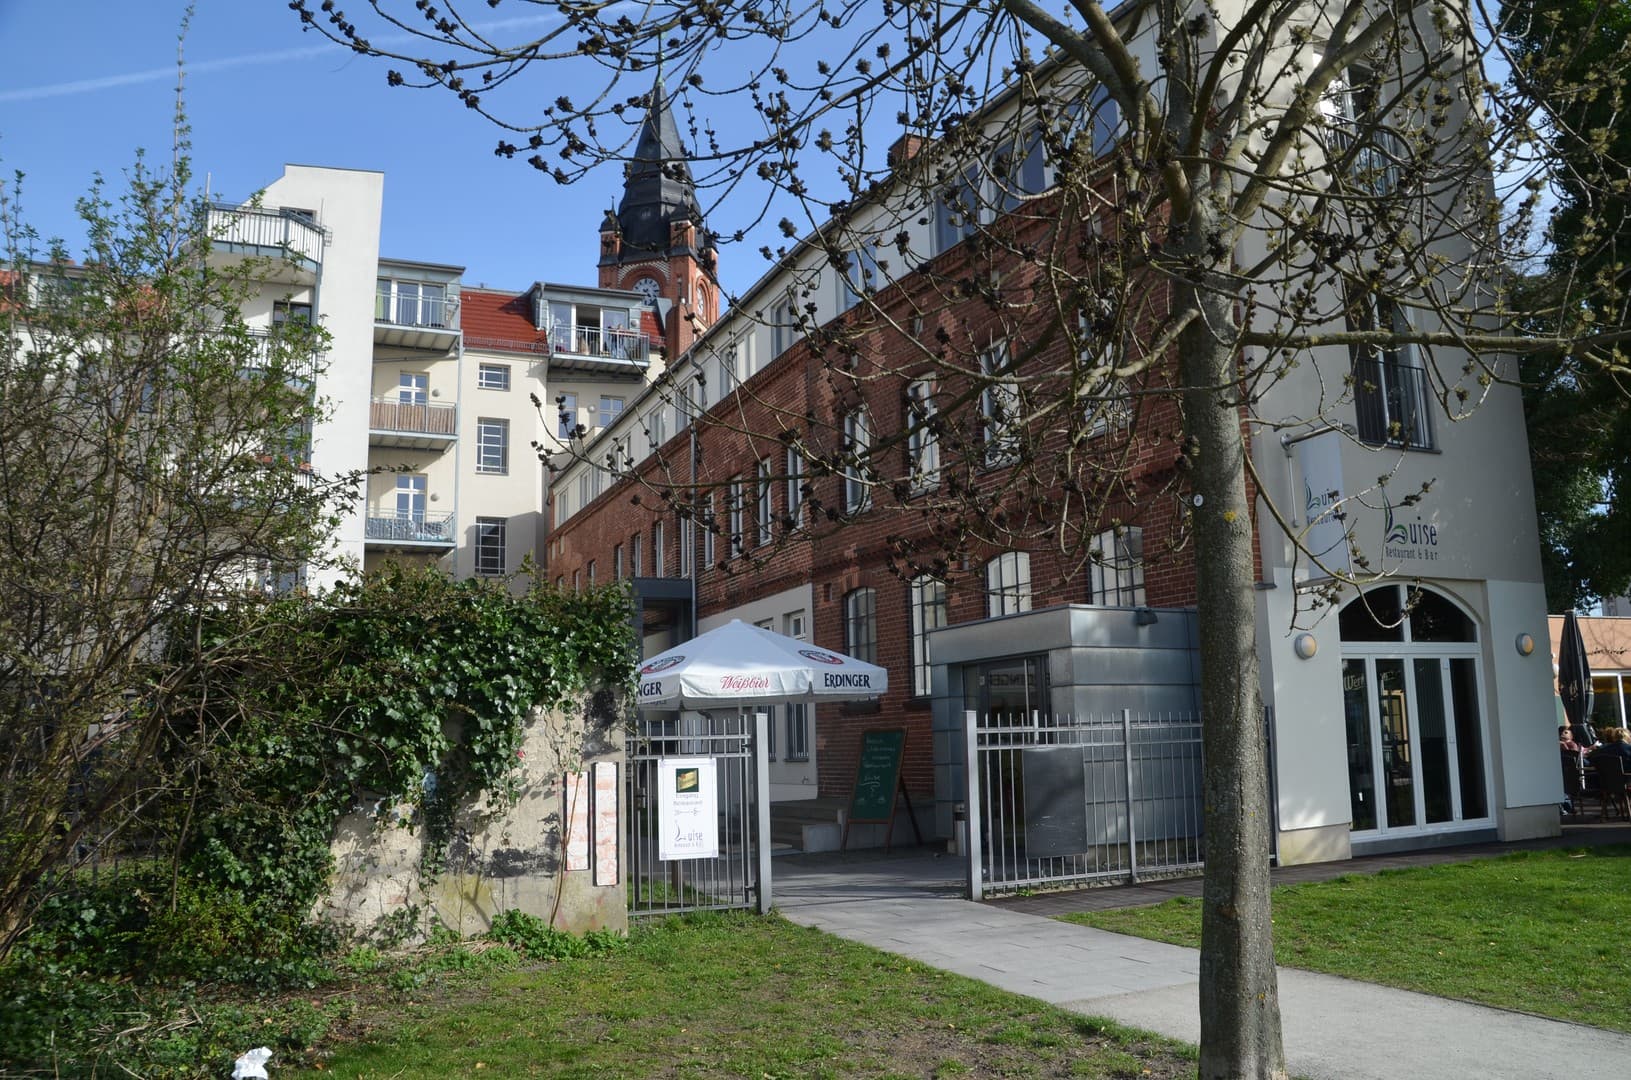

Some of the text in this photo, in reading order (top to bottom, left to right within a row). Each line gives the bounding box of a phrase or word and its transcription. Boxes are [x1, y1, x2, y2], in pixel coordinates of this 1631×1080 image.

[1382, 486, 1438, 546] Luise
[1424, 548, 1440, 561] Bar
[824, 672, 871, 688] ERDINGER
